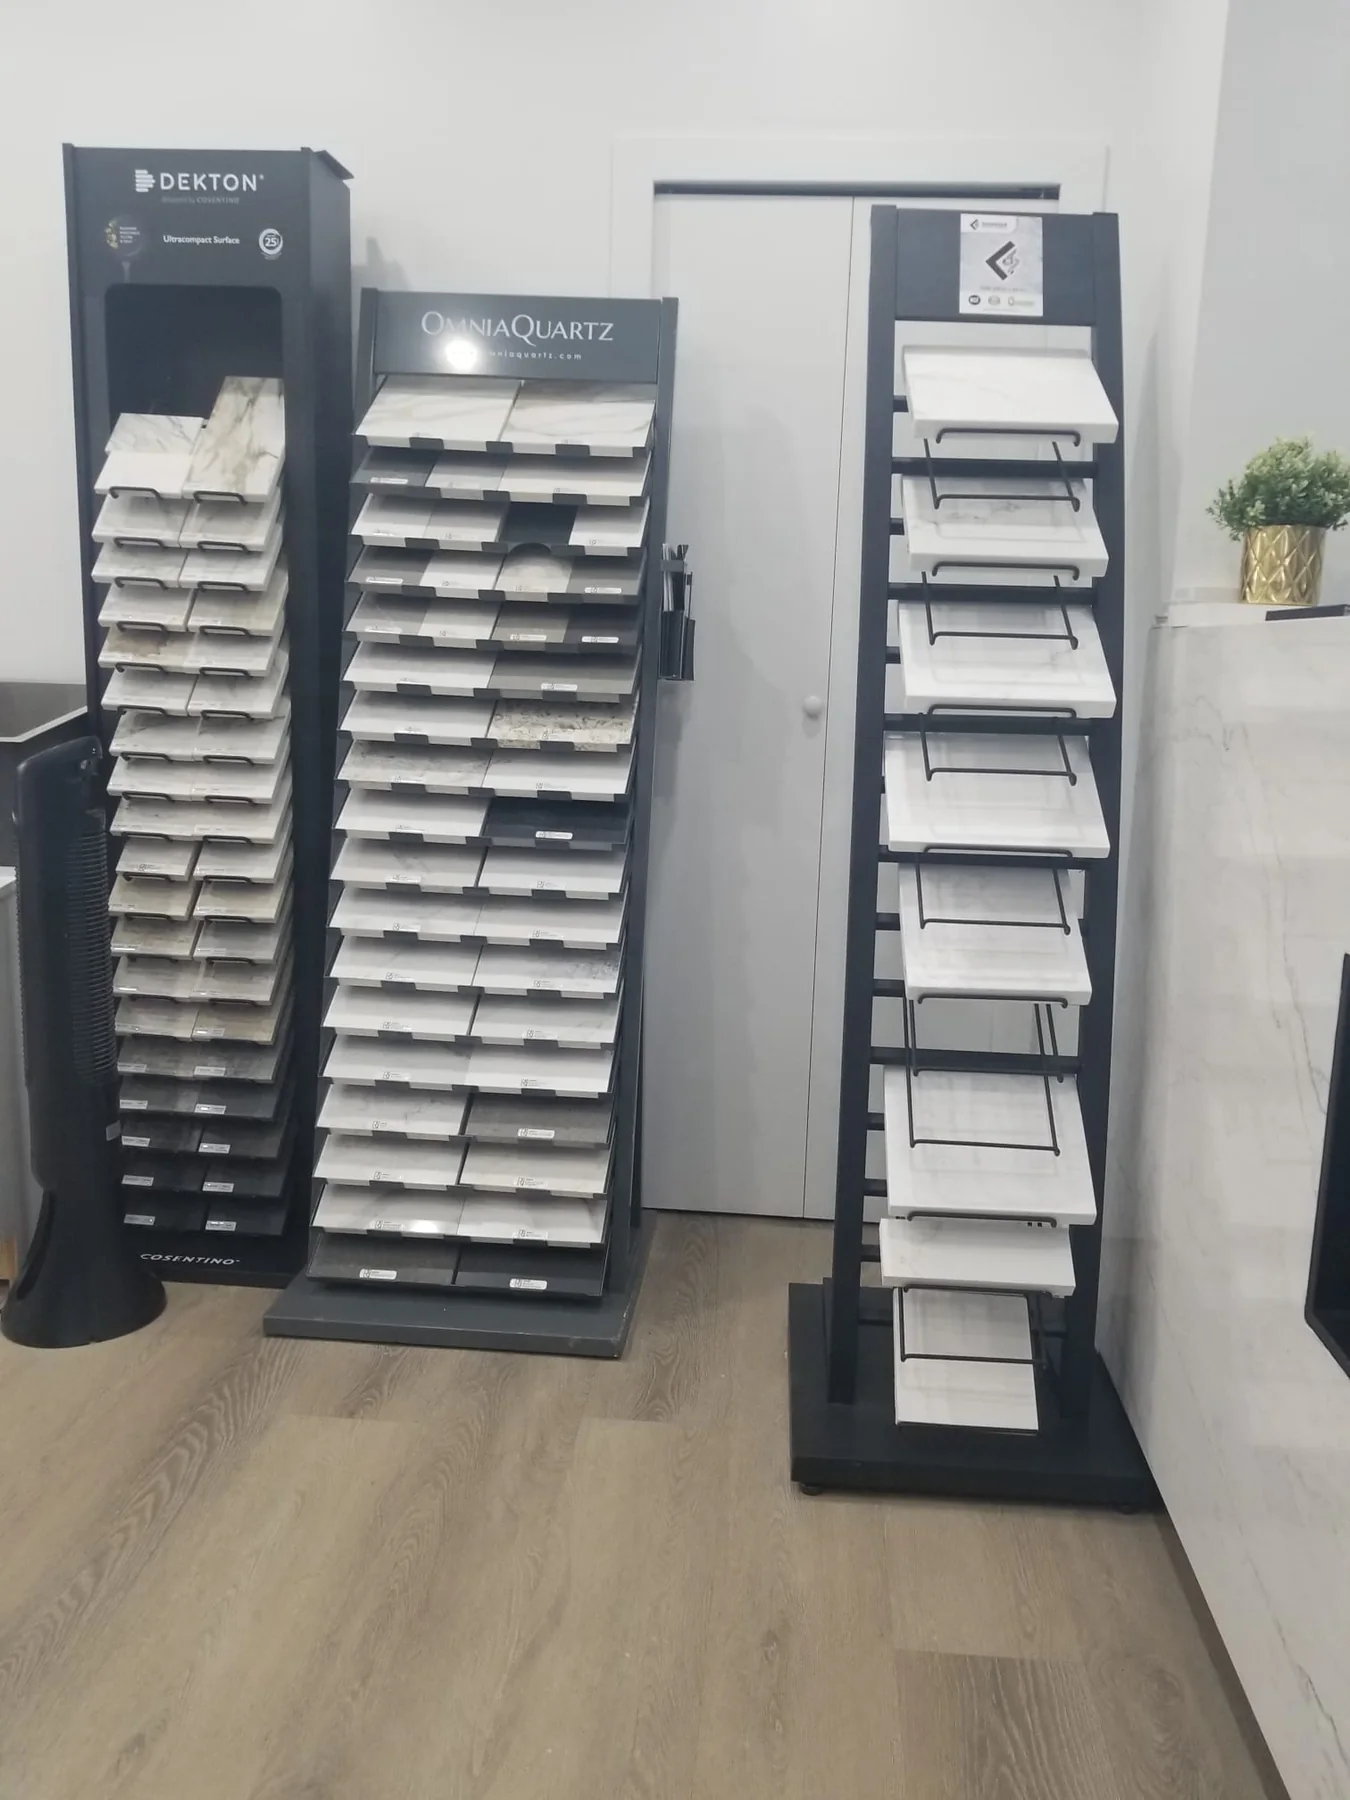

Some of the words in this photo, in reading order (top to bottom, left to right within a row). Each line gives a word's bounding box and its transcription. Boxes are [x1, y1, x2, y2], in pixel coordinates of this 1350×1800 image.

[163, 234, 212, 246] Ultracompact
[213, 235, 240, 245] Surface
[264, 237, 277, 247] 25
